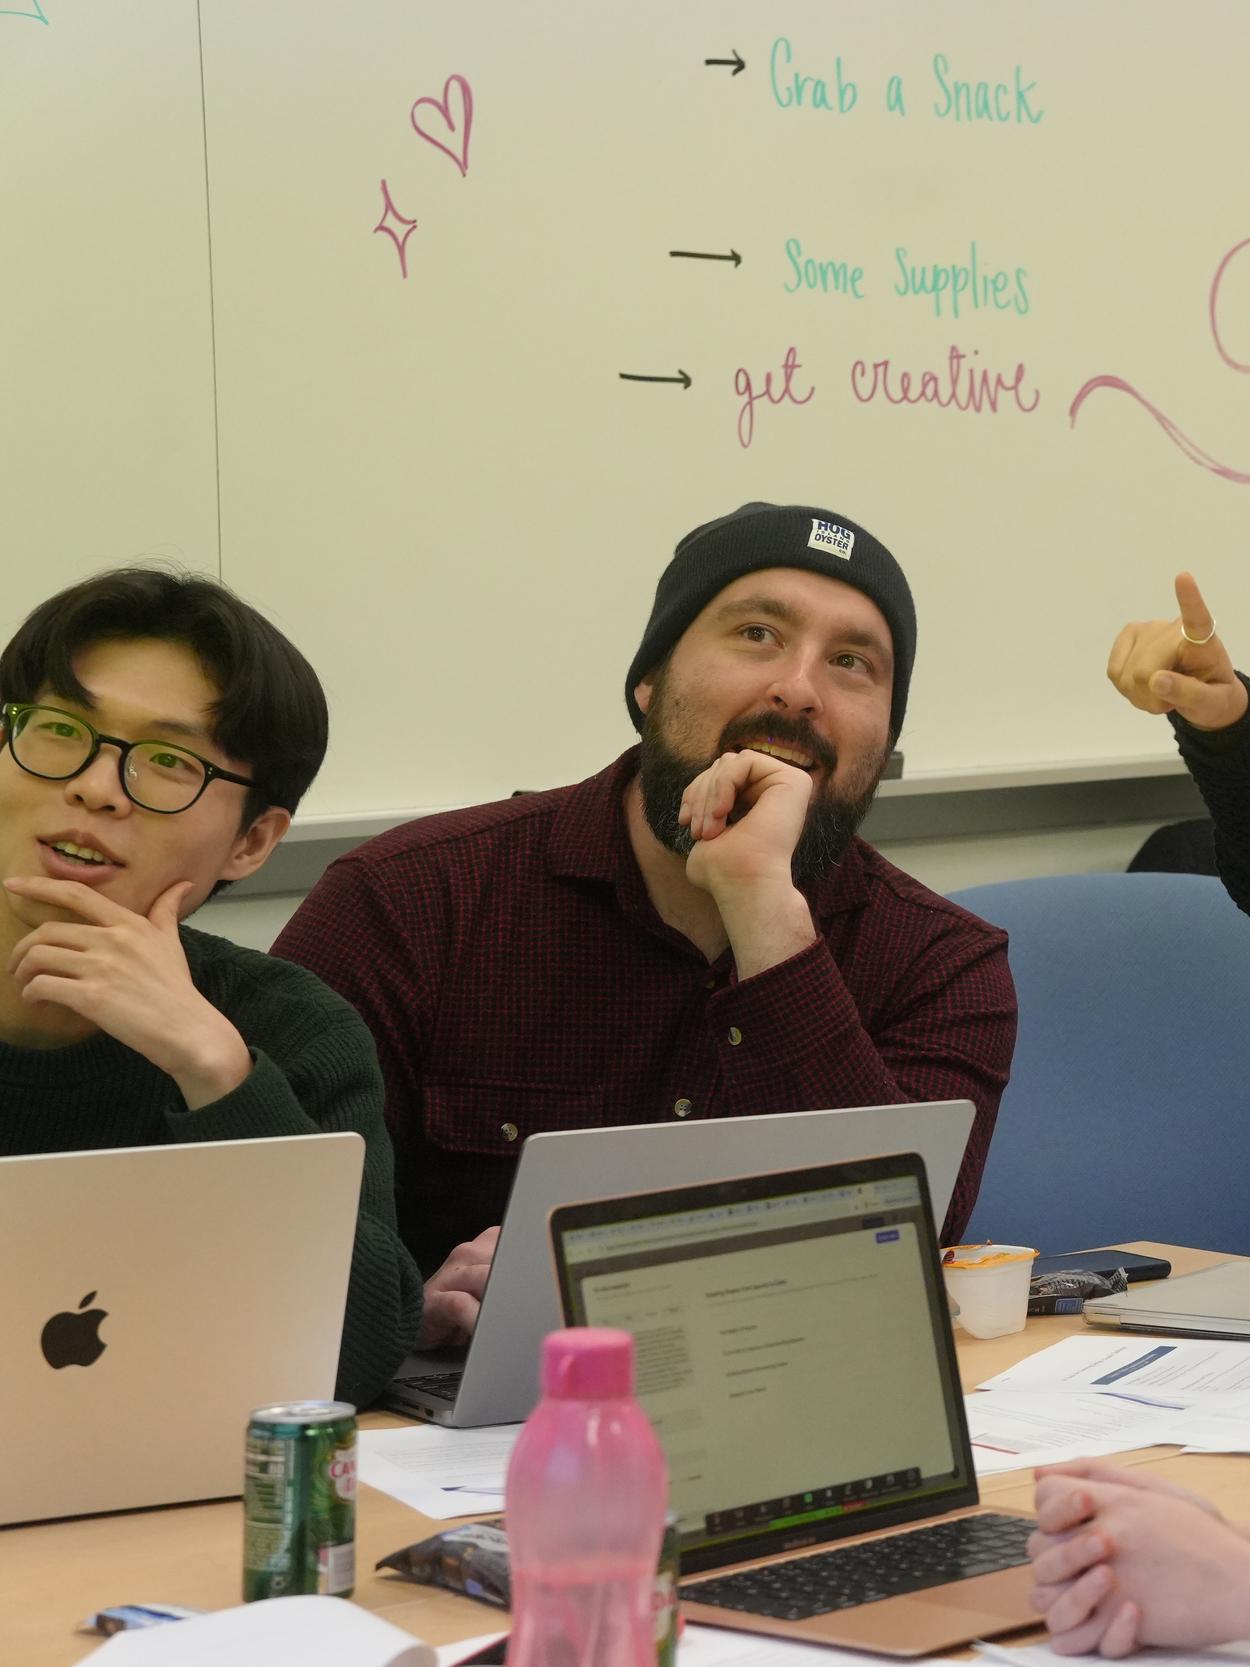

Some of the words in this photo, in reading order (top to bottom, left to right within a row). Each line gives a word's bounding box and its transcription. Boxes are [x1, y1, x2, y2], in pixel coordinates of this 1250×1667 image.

[886, 75, 906, 117] a
[932, 53, 1045, 125] Snack
[784, 238, 864, 300] Some
[735, 346, 815, 448] get
[851, 344, 1040, 413] creative
[814, 533, 849, 550] OYSTER
